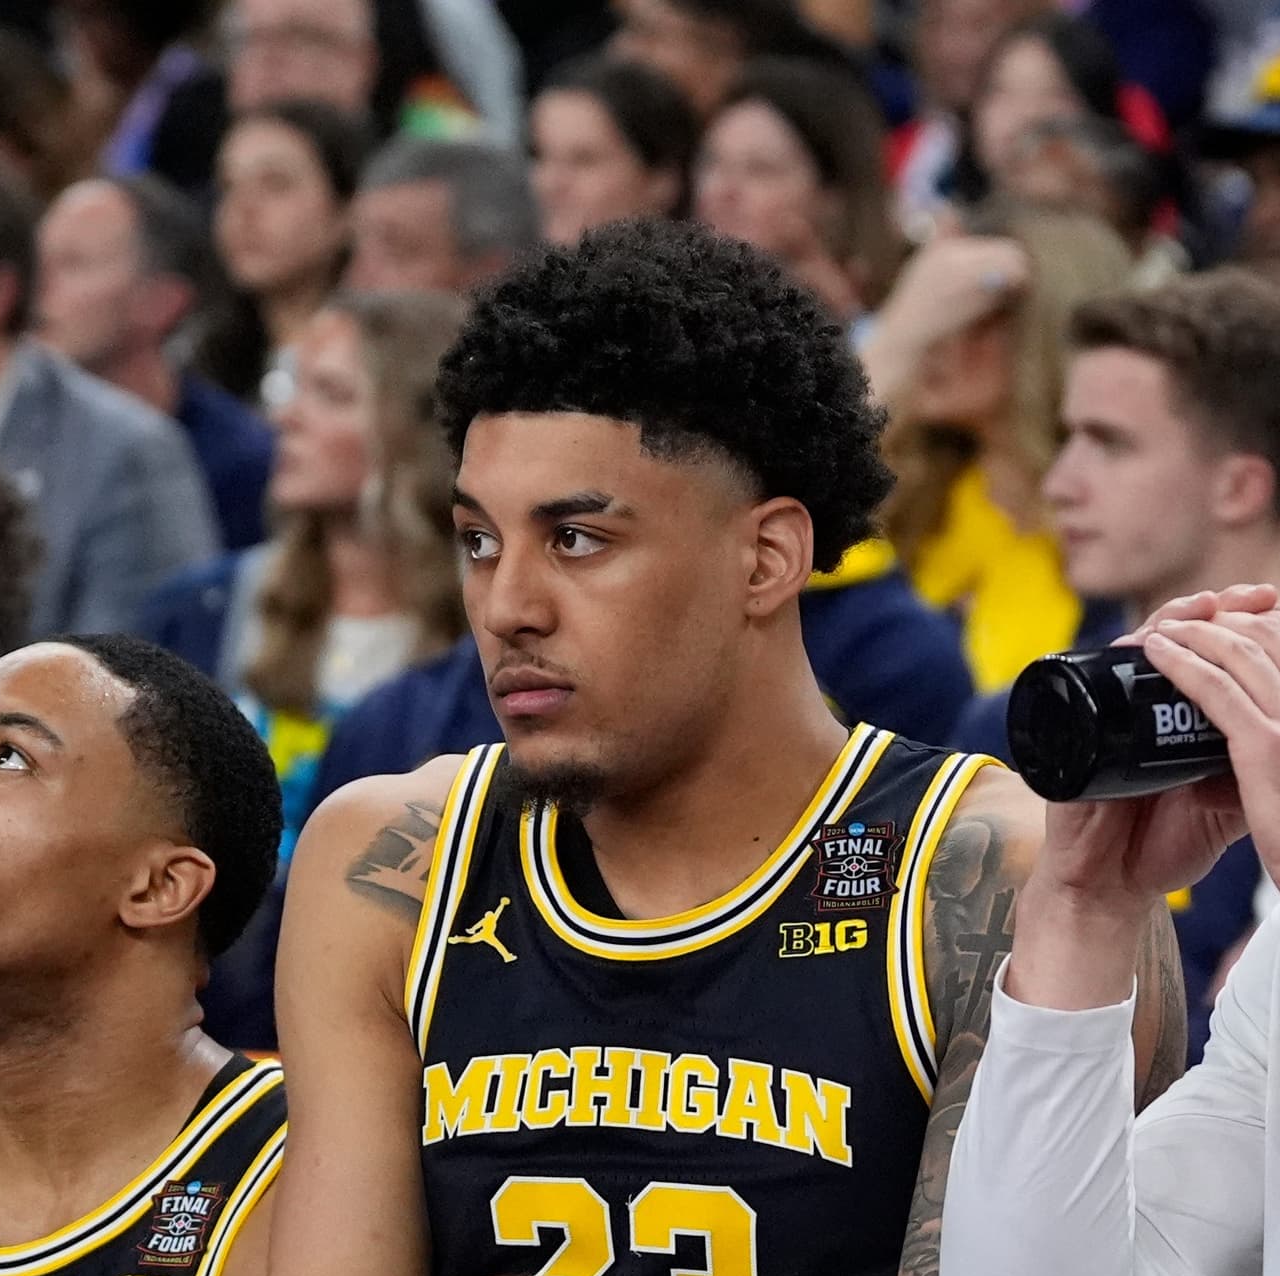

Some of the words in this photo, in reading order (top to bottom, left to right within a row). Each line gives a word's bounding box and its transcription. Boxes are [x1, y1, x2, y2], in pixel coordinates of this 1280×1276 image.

[1155, 732, 1196, 747] SPORTS
[824, 838, 884, 858] FINAL
[823, 877, 881, 897] FOUR
[823, 898, 880, 908] INDIANAPOLIS
[422, 1045, 853, 1168] MICHIGAN
[161, 1195, 211, 1215] FINAL
[147, 1233, 197, 1253] FOUR
